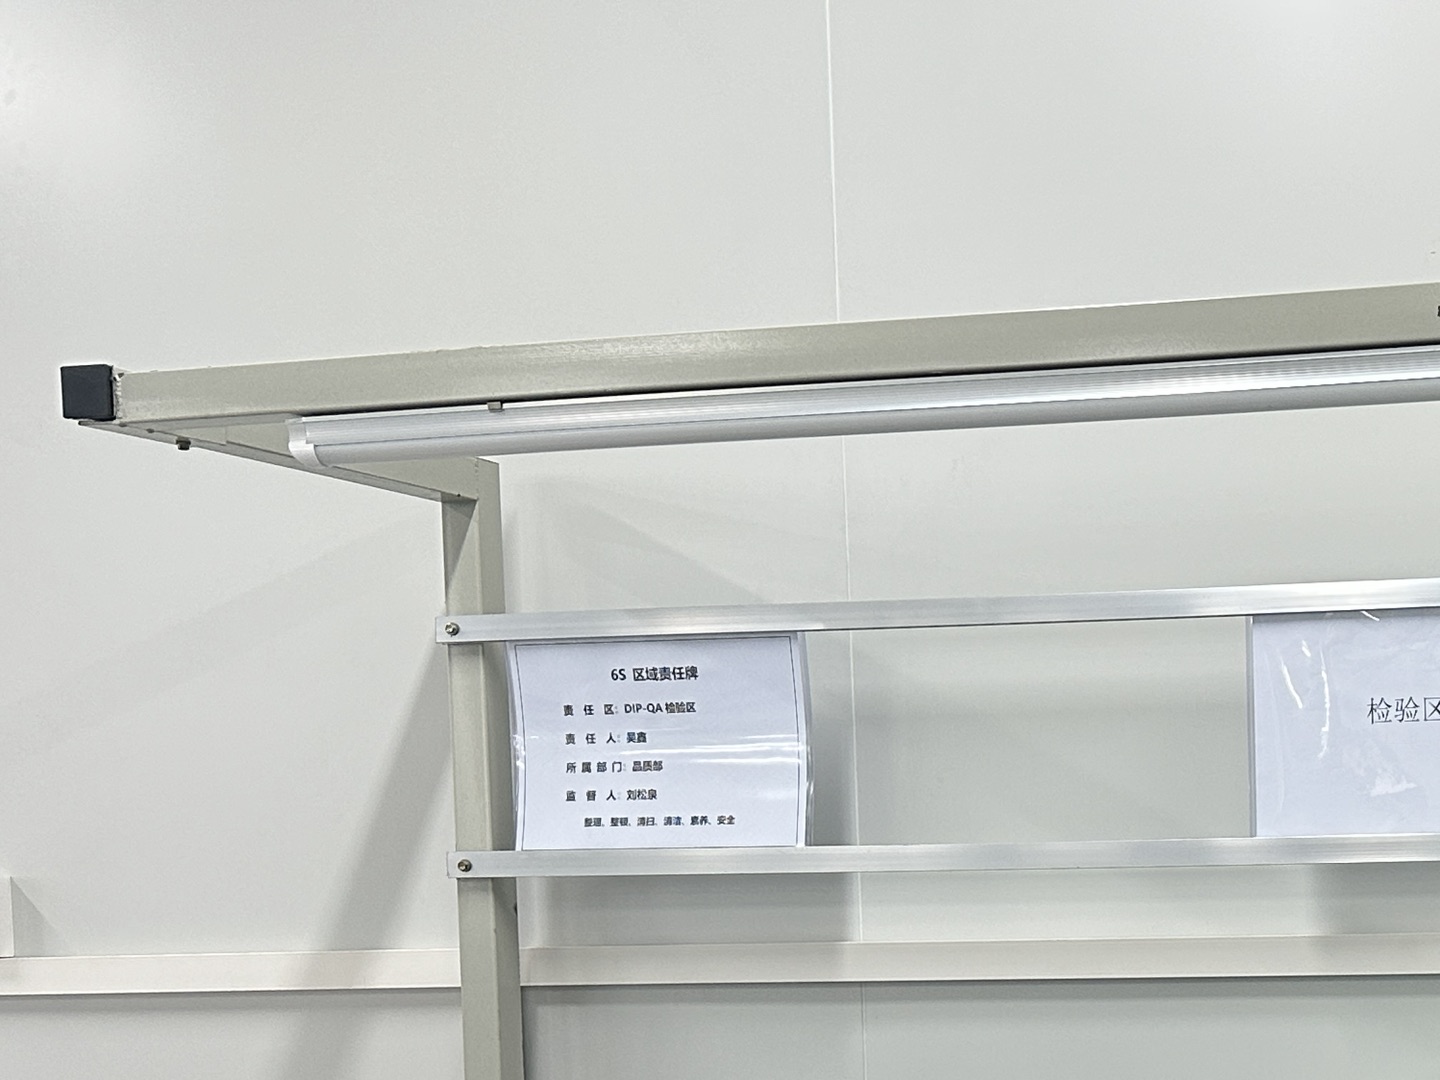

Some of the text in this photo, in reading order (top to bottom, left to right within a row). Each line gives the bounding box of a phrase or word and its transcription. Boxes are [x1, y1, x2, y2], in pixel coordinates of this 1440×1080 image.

[610, 665, 699, 682] 6S 区域责任牌
